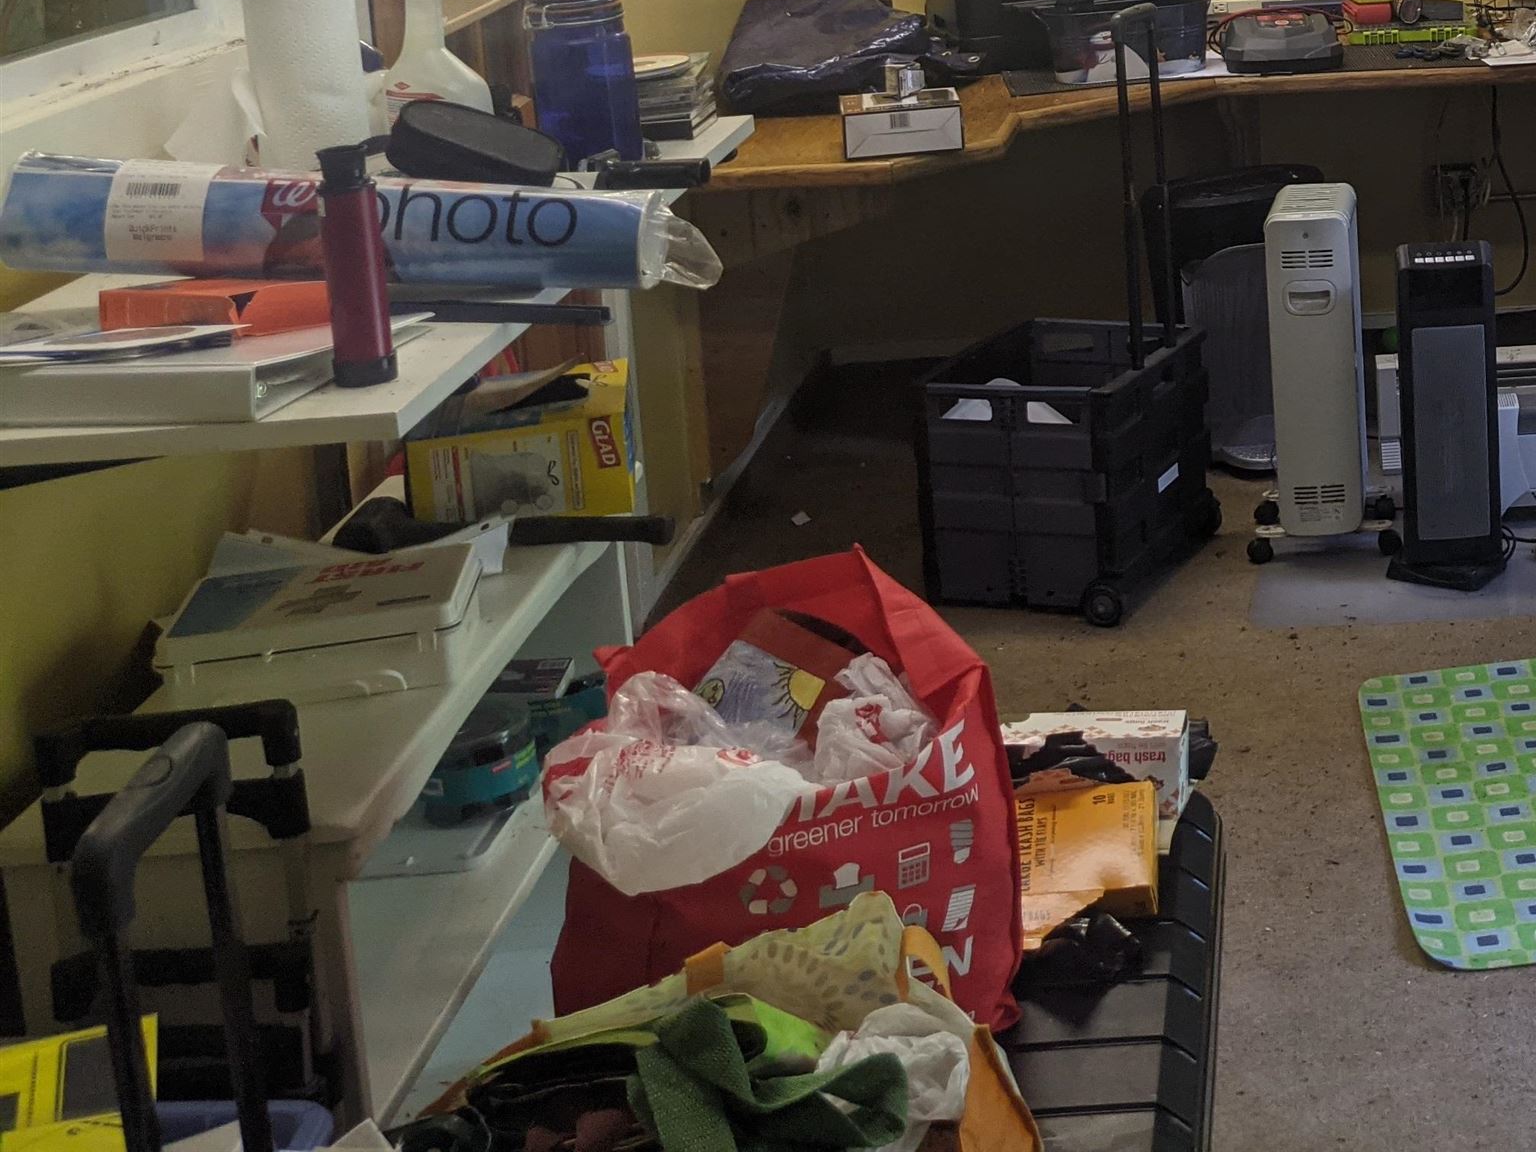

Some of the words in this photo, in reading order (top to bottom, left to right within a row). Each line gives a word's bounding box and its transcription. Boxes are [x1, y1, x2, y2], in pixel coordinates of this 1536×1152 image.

[379, 183, 578, 247] hoto
[592, 420, 616, 466] GLAD
[1106, 750, 1131, 764] bag
[1134, 750, 1166, 763] trash
[768, 815, 863, 857] greener
[871, 784, 979, 828] tomorrow
[1018, 798, 1035, 822] BAGS
[1019, 821, 1034, 855] TRASH
